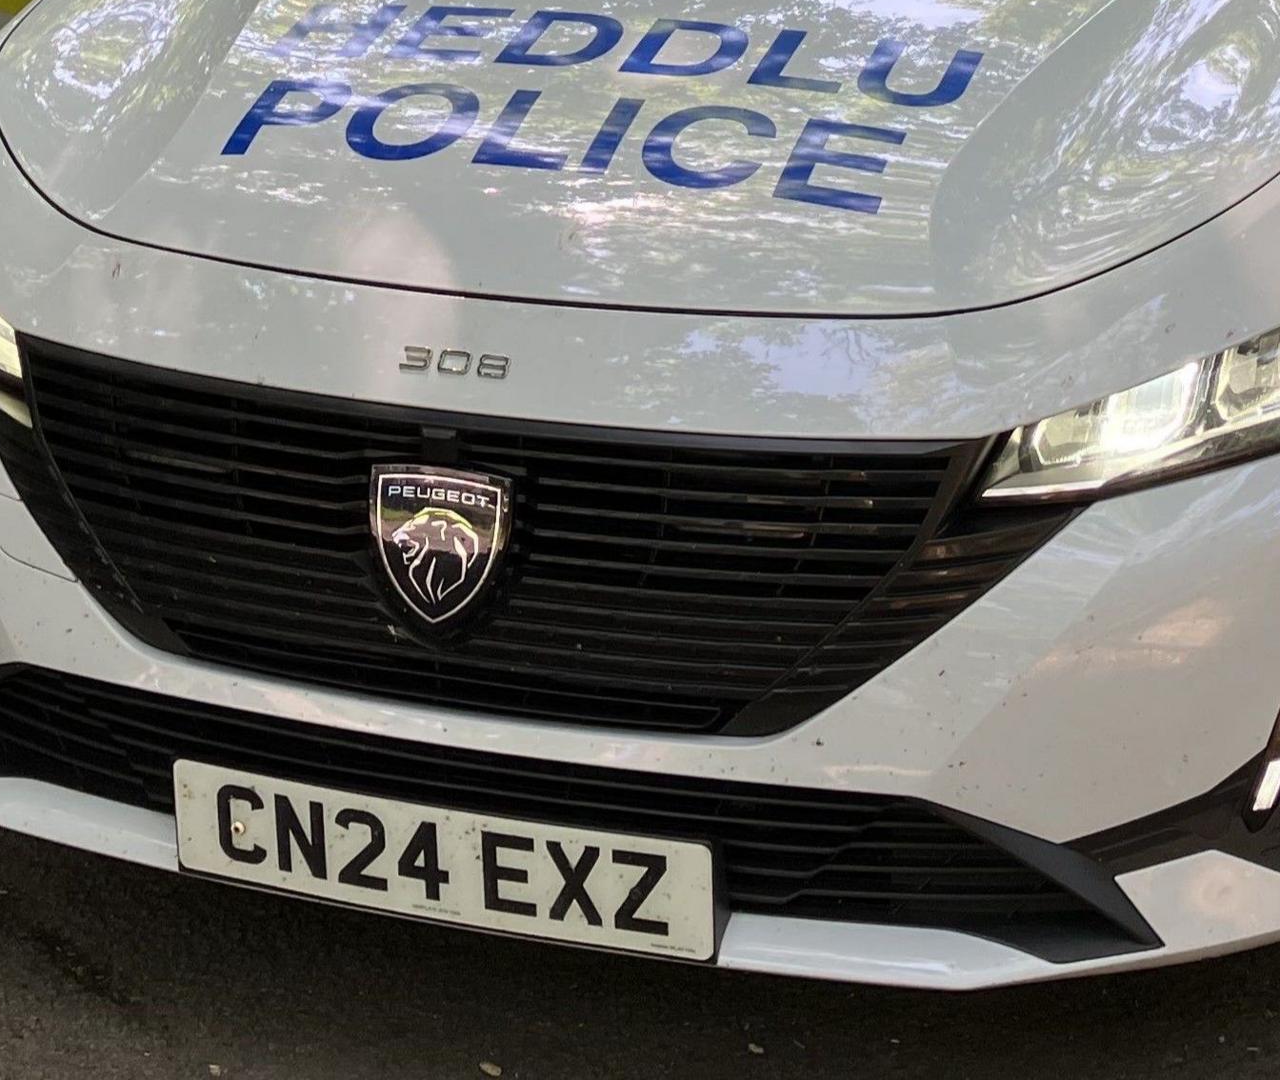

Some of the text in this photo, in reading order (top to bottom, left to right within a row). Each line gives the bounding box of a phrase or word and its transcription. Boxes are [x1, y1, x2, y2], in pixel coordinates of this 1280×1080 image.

[269, 3, 985, 109] HEDDLU
[220, 78, 908, 216] POLICE
[398, 344, 511, 380] 308
[387, 485, 491, 508] PEUGEOT
[215, 783, 670, 937] CN24 EXZ
